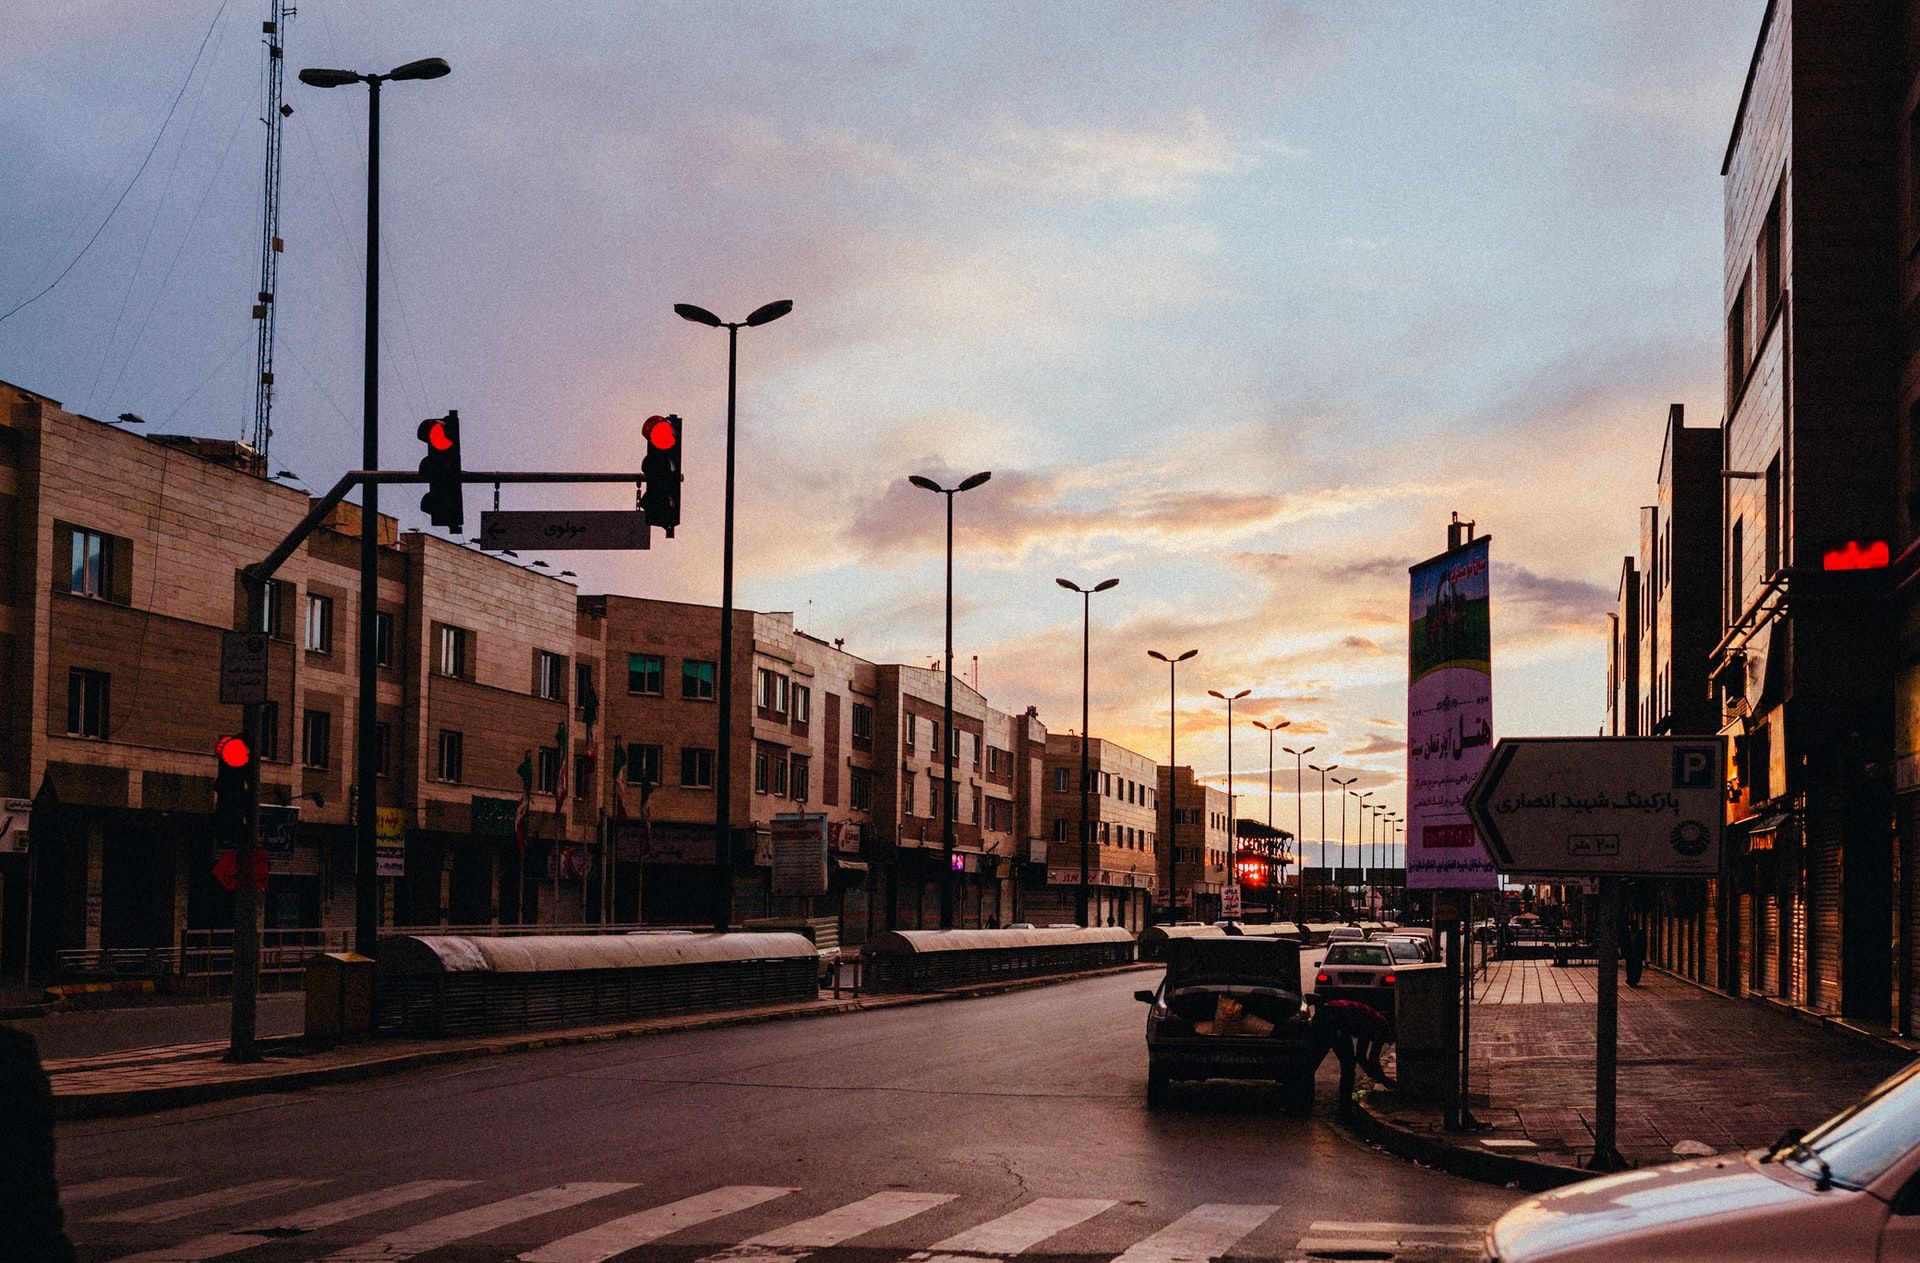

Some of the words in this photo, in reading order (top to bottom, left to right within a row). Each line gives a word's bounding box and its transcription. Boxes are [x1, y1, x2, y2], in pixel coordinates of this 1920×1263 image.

[544, 520, 586, 539] مولوی
[1453, 713, 1491, 761] هتل
[1684, 753, 1707, 783] P
[1496, 792, 1556, 814] انصاری
[1560, 791, 1609, 814] شهید
[1612, 790, 1679, 815] پارکینگ
[1596, 838, 1615, 852] ۲۰۰
